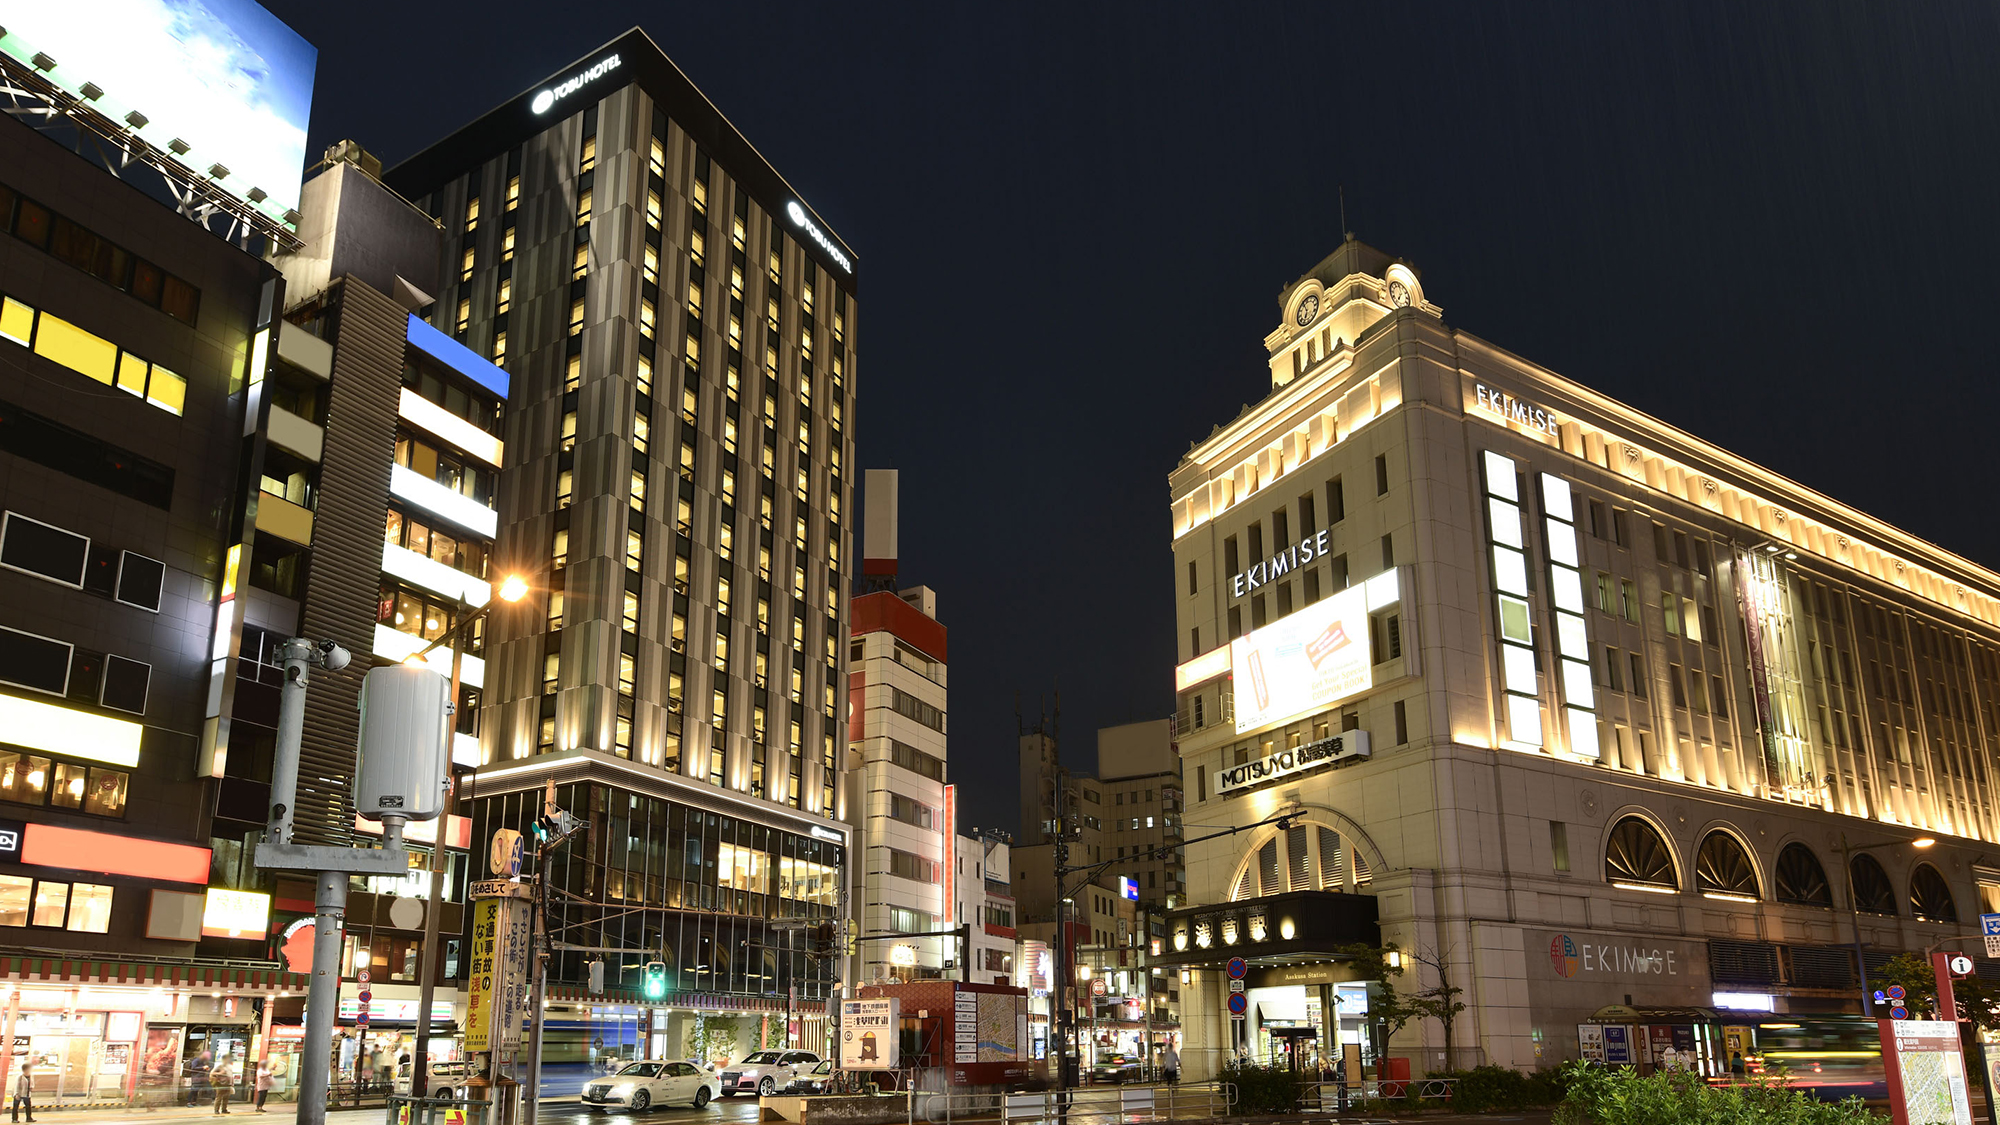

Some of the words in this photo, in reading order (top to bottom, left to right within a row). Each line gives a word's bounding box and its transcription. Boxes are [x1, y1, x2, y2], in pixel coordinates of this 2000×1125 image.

[553, 73, 584, 101] TOBU
[585, 53, 622, 84] HOTEL
[805, 218, 827, 249] TOBU
[827, 241, 852, 275] HOTEL
[1476, 383, 1558, 437] EKIMISE
[1234, 529, 1330, 598] EKIMISE
[1311, 683, 1342, 701] COUPON
[482, 904, 497, 991] 交通事故の
[1582, 944, 1677, 975] EKIMISE
[1308, 971, 1328, 979] Station
